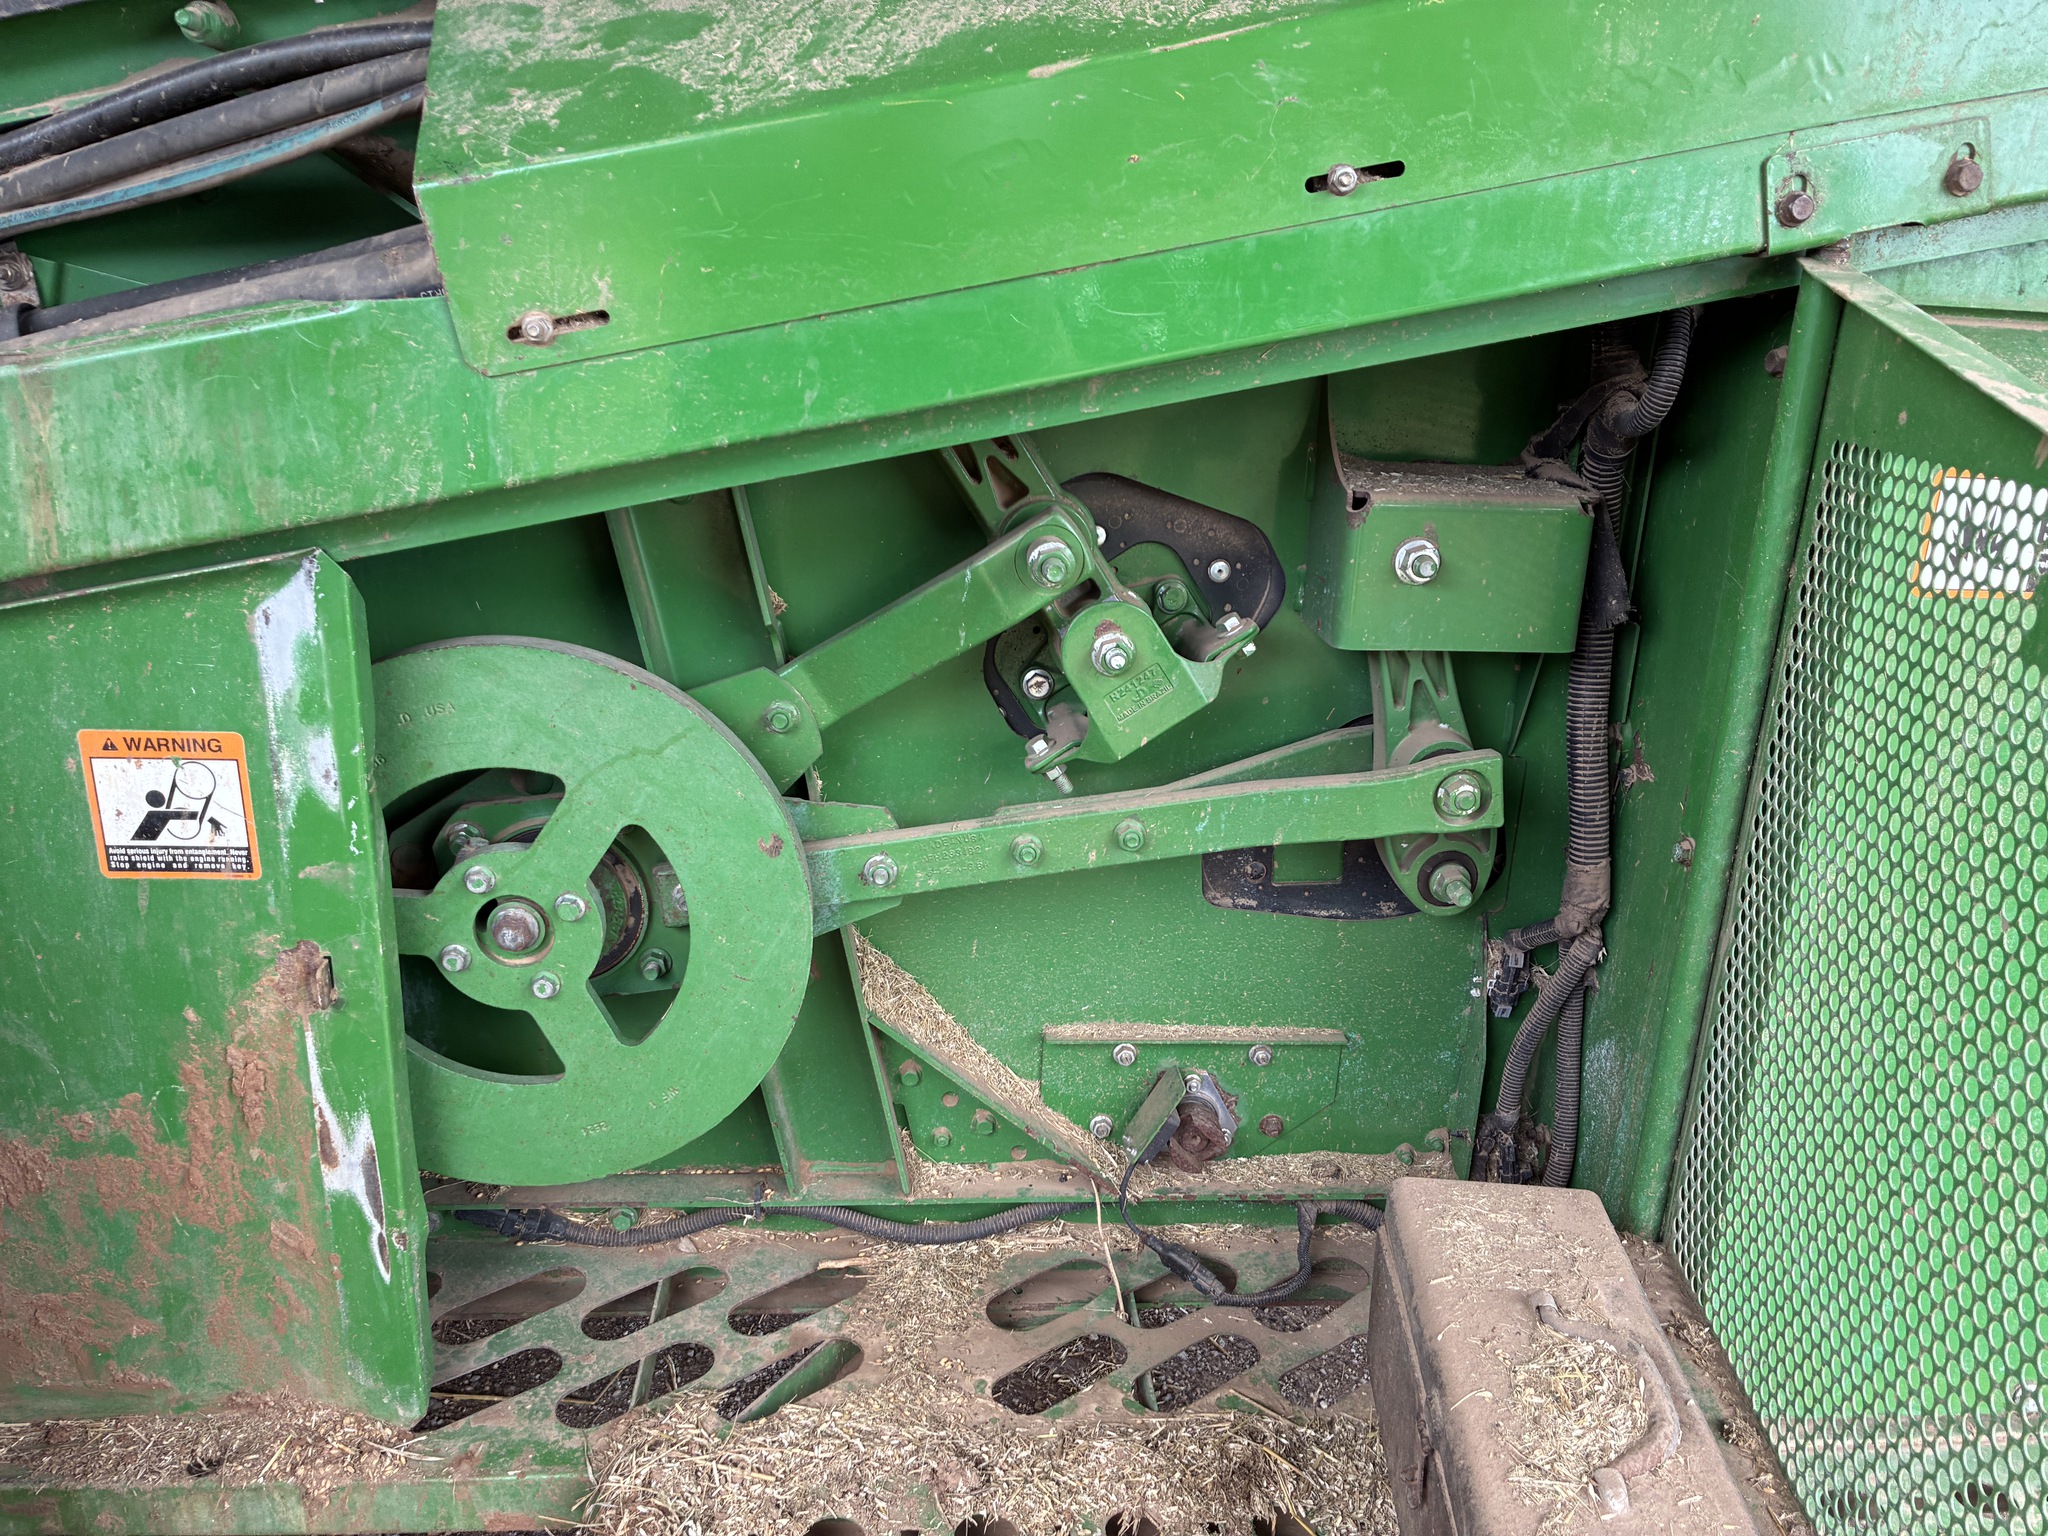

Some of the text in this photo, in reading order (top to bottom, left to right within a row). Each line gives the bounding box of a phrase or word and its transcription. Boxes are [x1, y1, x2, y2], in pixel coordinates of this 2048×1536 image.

[424, 702, 456, 717] USA
[123, 736, 223, 754] WARNING
[108, 847, 126, 855] Avoid
[126, 847, 150, 856] serious
[150, 847, 168, 857] injury
[168, 847, 184, 855] from
[229, 848, 249, 856] Never
[109, 854, 129, 862] raise
[130, 854, 155, 862] shield
[156, 854, 174, 862] with
[190, 855, 216, 863] engine
[110, 861, 250, 871] Stop engine and remove key.
